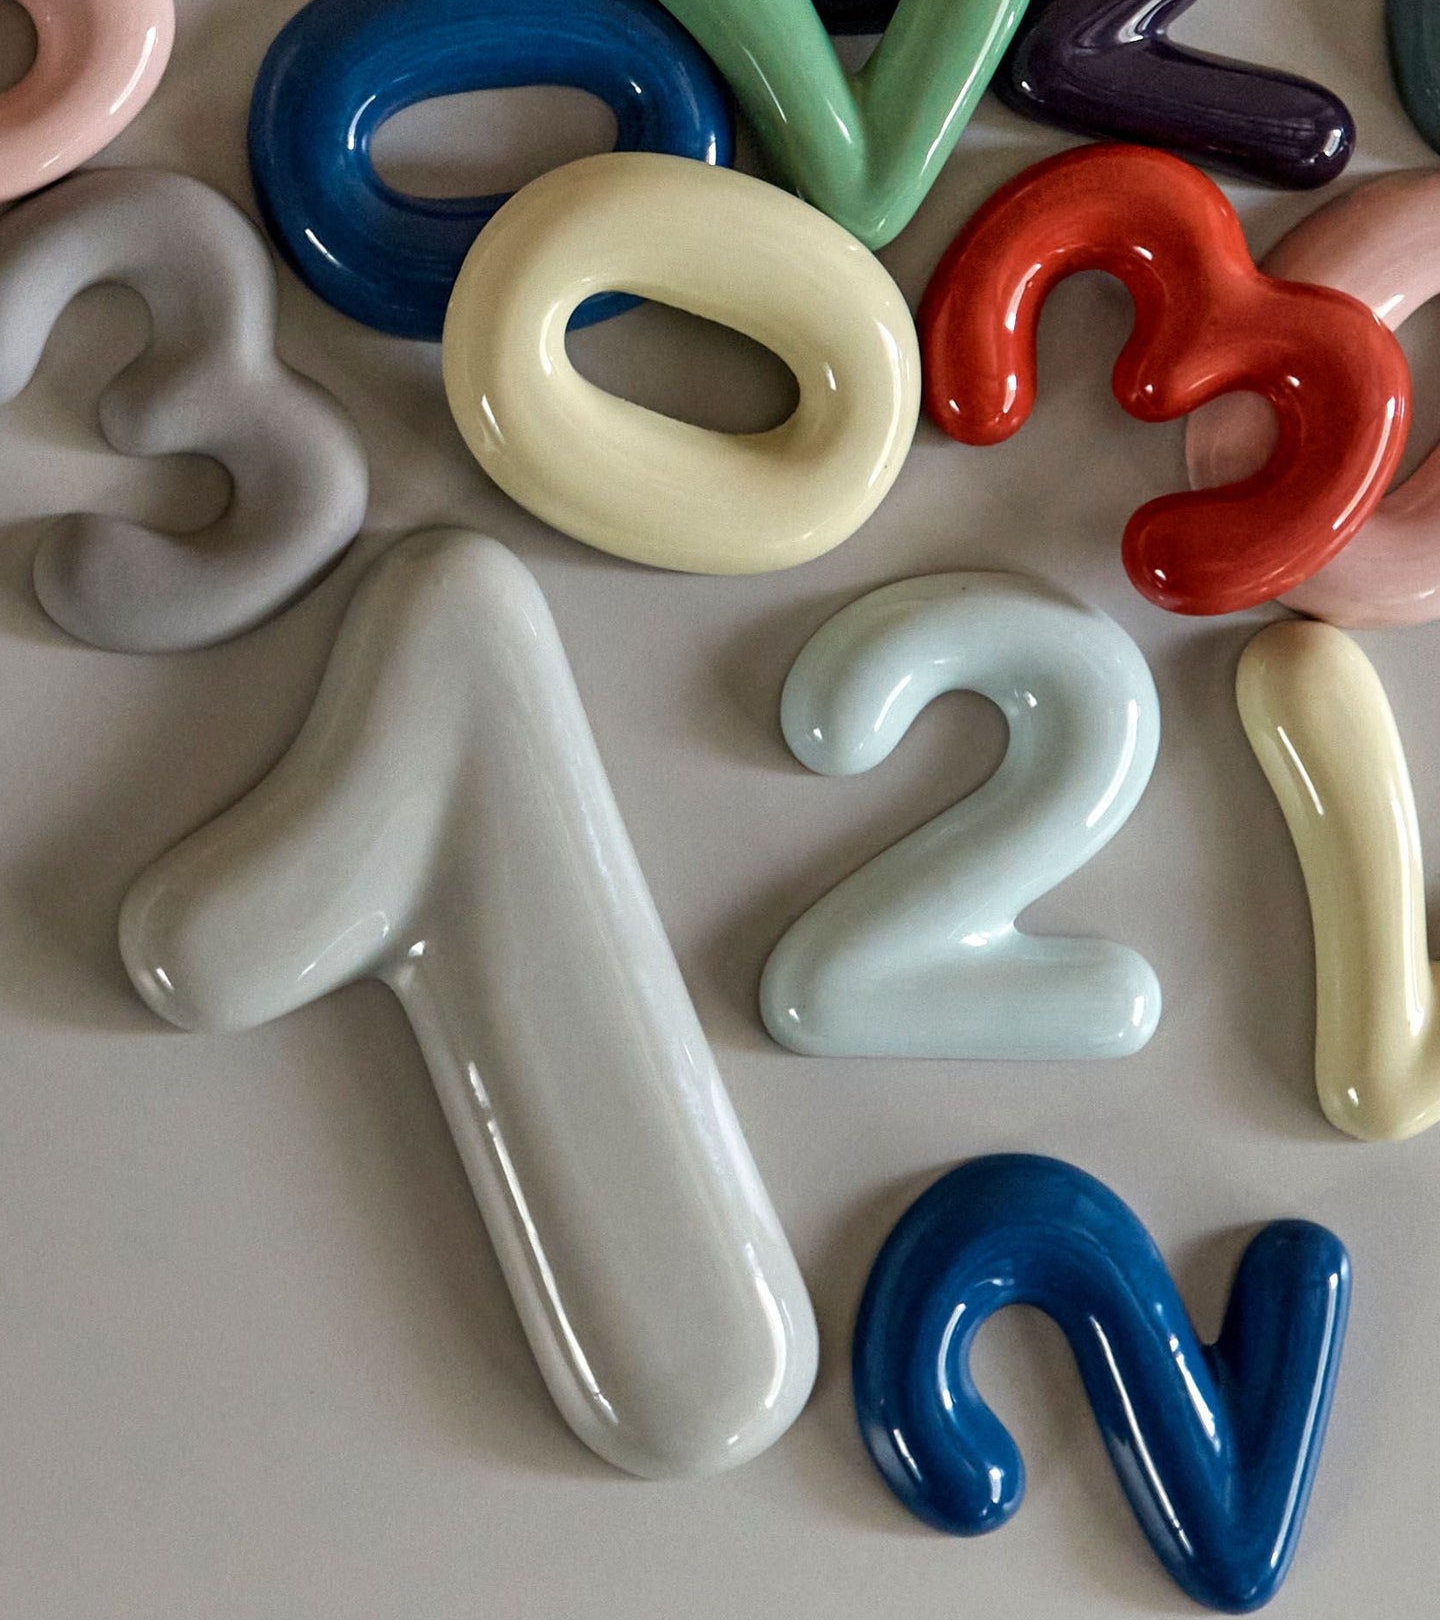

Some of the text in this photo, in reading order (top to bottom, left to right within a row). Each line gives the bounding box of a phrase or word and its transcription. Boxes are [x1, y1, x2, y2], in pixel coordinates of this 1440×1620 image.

[442, 151, 920, 575] 0
[921, 143, 1410, 615] 3
[120, 526, 820, 1479] 1
[758, 570, 1161, 1059] 2
[851, 1152, 1351, 1614] 2
